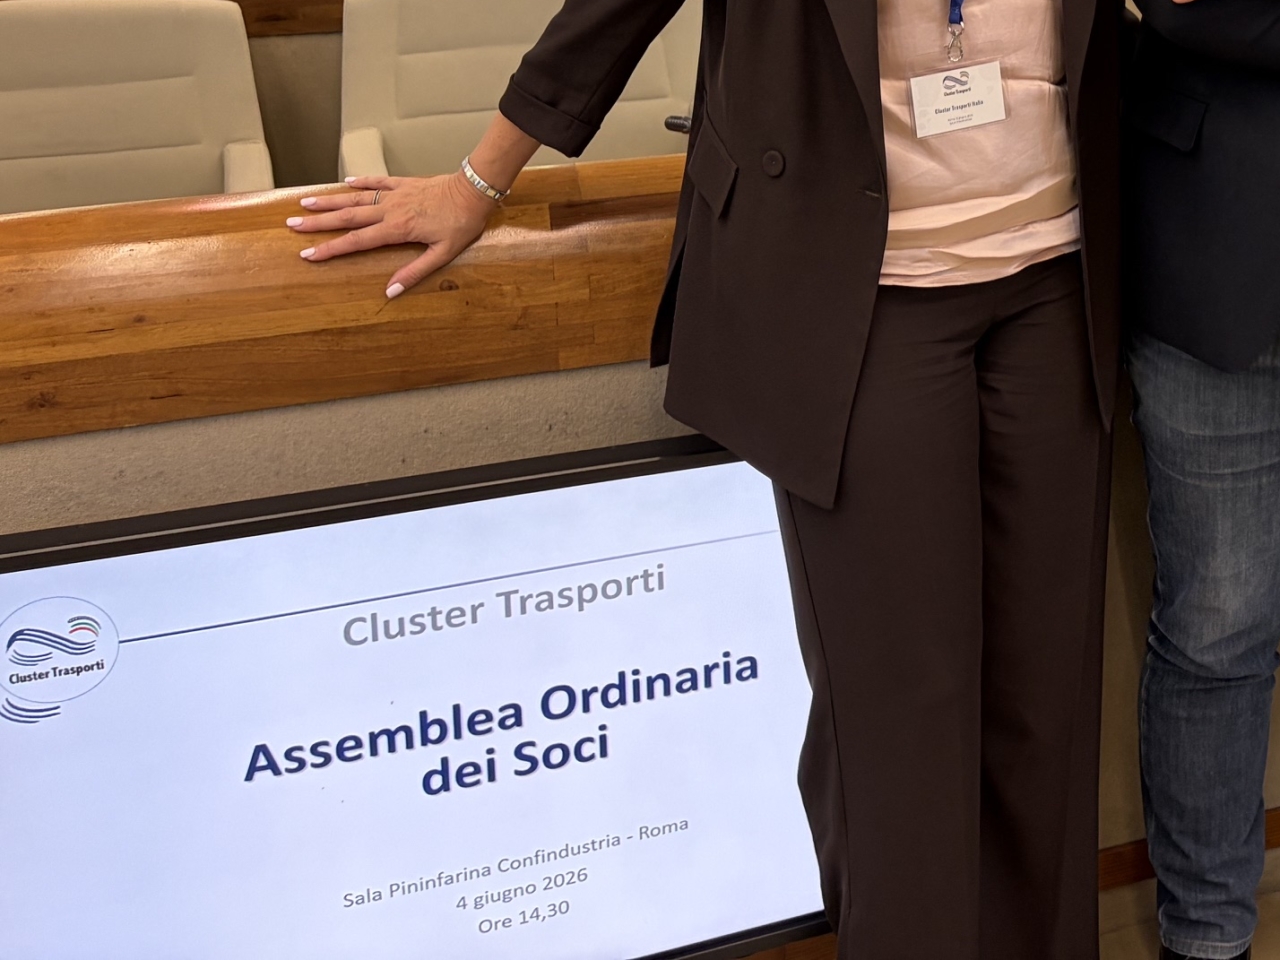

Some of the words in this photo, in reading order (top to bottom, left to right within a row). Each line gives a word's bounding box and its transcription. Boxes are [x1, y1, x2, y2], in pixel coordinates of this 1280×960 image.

[343, 601, 486, 647] Cluster
[495, 562, 666, 619] Trasporti
[9, 670, 50, 685] Cluster
[51, 658, 105, 678] Trasporti
[243, 702, 525, 784] Assemblea
[539, 650, 760, 721] Ordinaria
[421, 746, 499, 796] dei
[513, 723, 610, 777] Soci
[343, 887, 384, 908] Sala
[389, 865, 492, 898] Pininfarina
[497, 835, 621, 873] Confindustria
[639, 819, 690, 841] Roma
[455, 895, 468, 910] 4
[473, 883, 537, 910] giugno
[542, 867, 588, 892] 2026
[478, 917, 513, 934] Ore
[518, 900, 571, 925] 14,30
